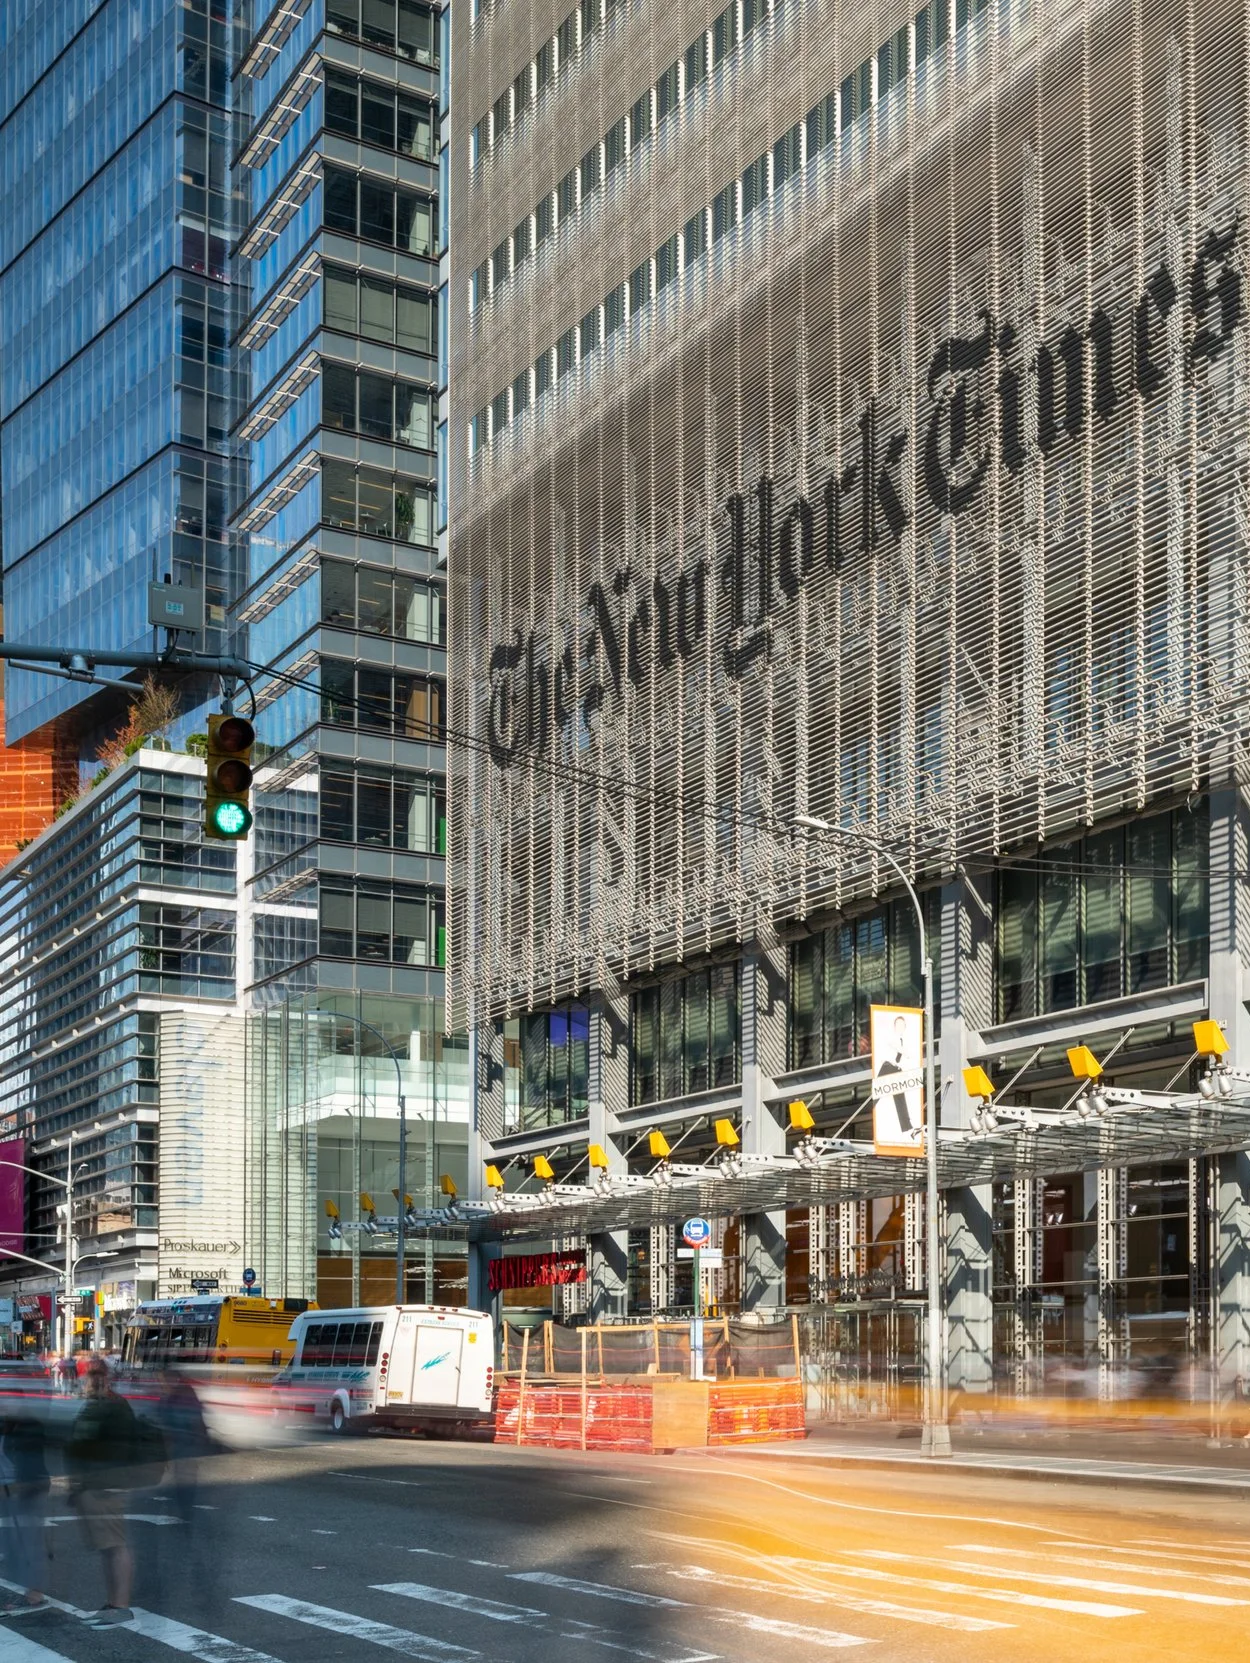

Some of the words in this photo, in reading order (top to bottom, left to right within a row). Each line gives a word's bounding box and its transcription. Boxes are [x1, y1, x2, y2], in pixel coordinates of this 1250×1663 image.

[490, 632, 576, 768] The
[583, 556, 712, 732] New
[722, 398, 909, 678] York
[923, 208, 1244, 515] Times
[874, 1077, 923, 1096] MORMON
[164, 1238, 228, 1253] Proskauer
[168, 1267, 229, 1280] Microsoft
[402, 1315, 412, 1323] 211
